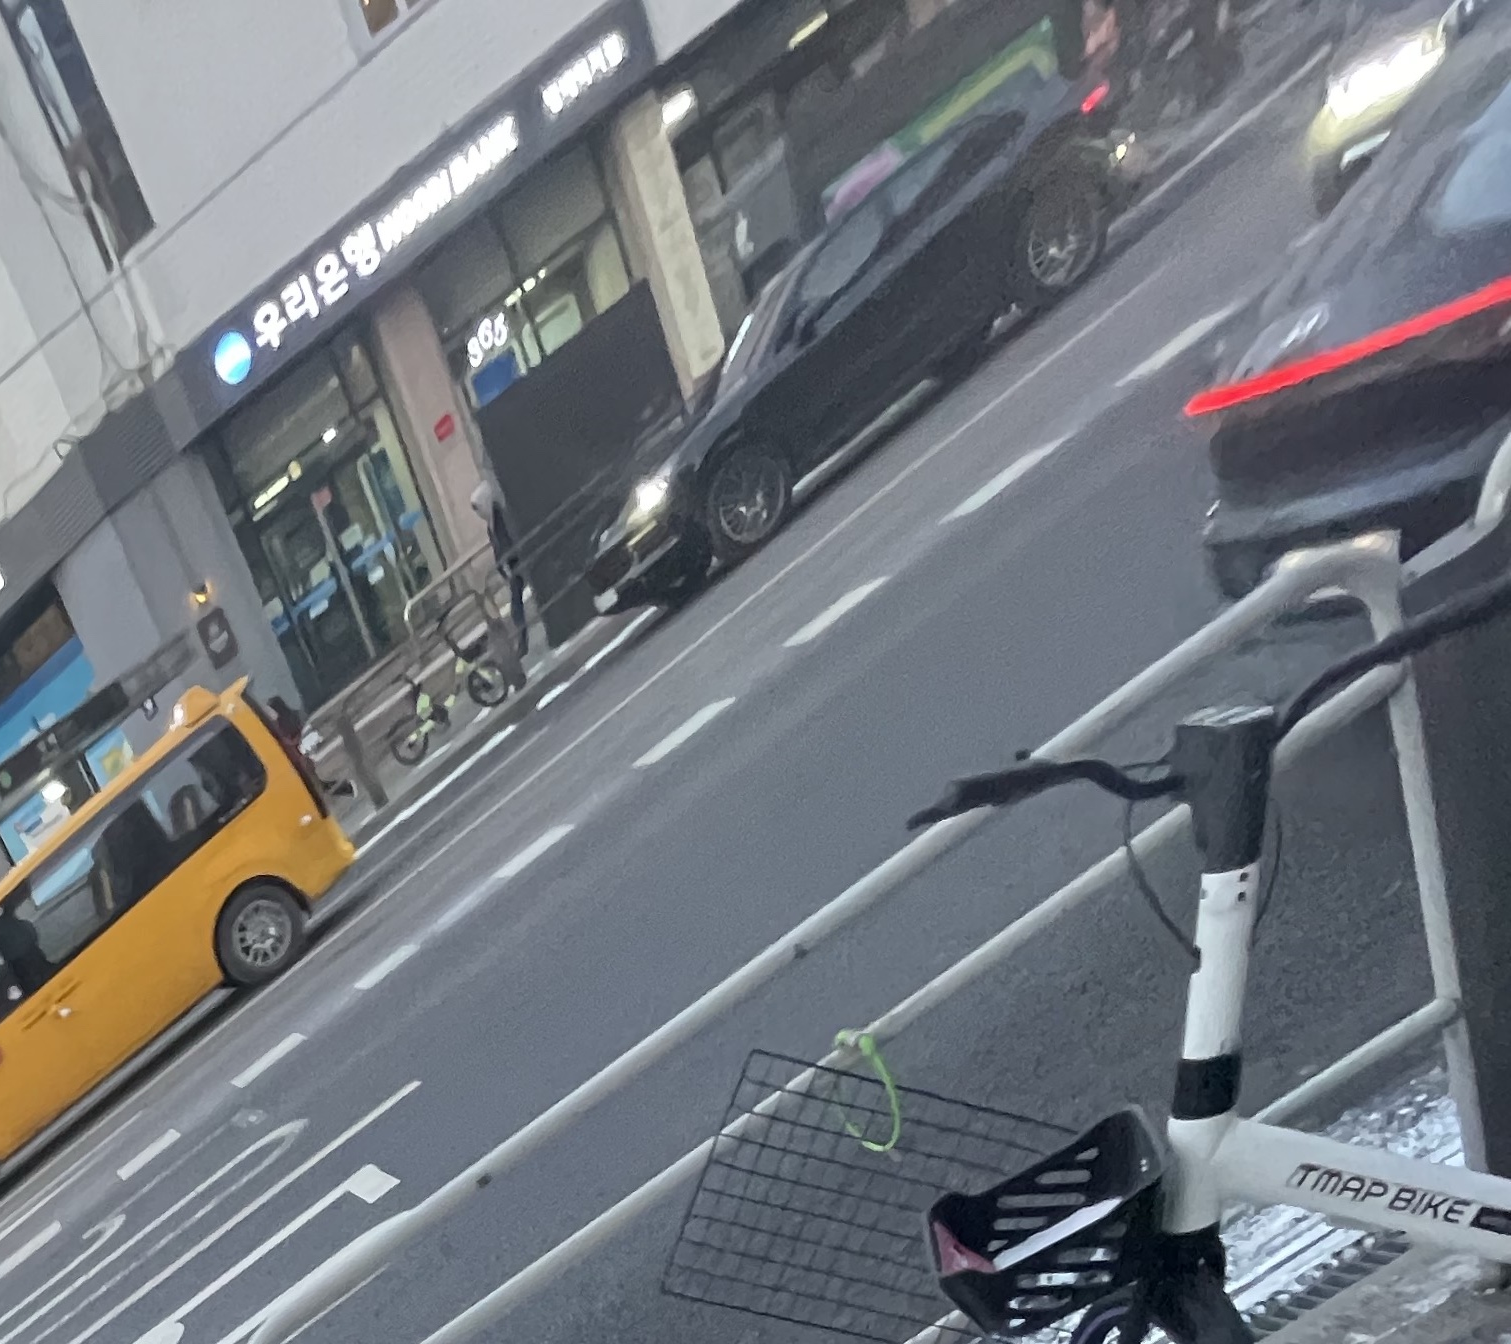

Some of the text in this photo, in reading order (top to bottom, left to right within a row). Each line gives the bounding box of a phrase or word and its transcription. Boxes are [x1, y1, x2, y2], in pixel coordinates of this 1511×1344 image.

[251, 222, 382, 352] 우리은행
[1288, 1163, 1472, 1224] TMAP BIKE
